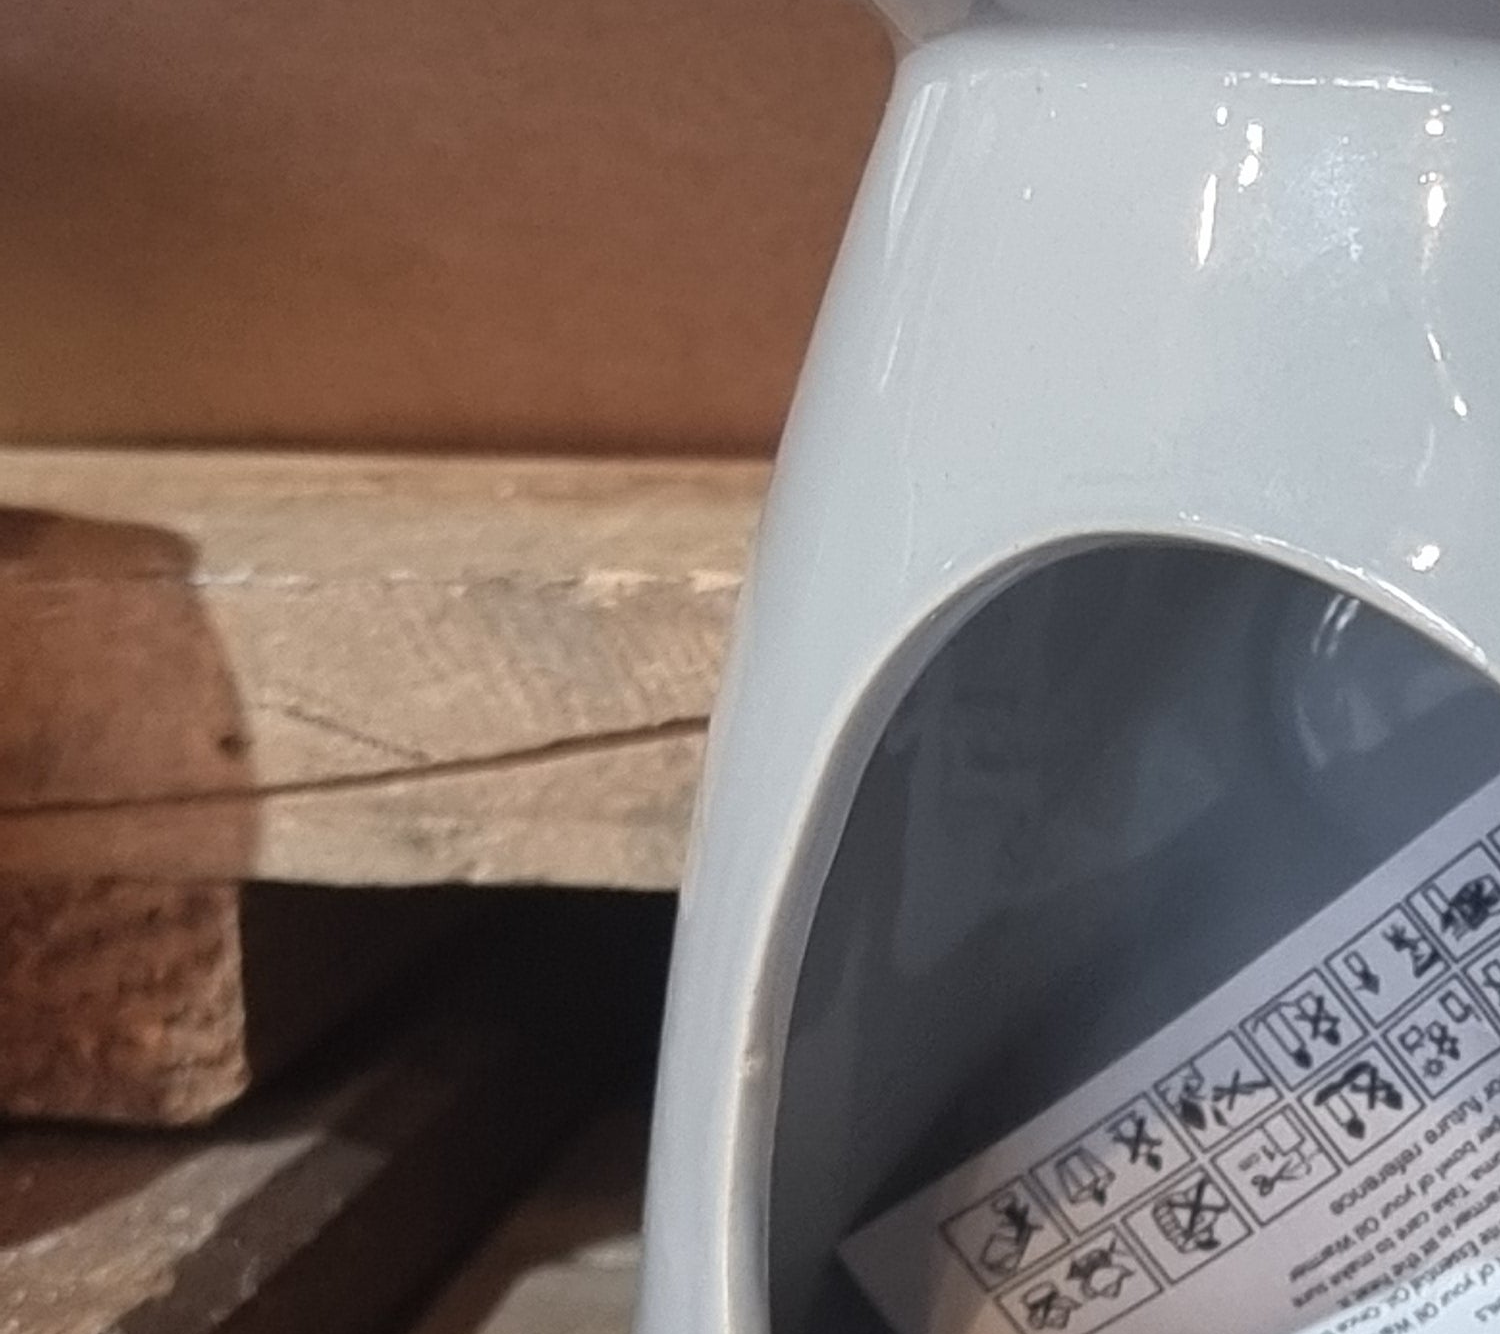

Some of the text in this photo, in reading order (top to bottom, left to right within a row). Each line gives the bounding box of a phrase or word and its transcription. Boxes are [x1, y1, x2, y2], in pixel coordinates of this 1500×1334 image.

[1423, 1095, 1484, 1146] future
[1434, 1139, 1479, 1180] bowl
[1329, 1141, 1424, 1216] reference
[1417, 1173, 1436, 1196] of
[1379, 1182, 1417, 1221] your
[1430, 1183, 1471, 1214] Take
[1352, 1215, 1381, 1242] Oil
[1394, 1210, 1430, 1242] care
[1436, 1223, 1455, 1241] is
[1289, 1234, 1357, 1283] Warmer
[1374, 1236, 1397, 1256] to
[1329, 1249, 1376, 1287] make
[1391, 1251, 1423, 1282] the
[1408, 1239, 1481, 1295] Essential
[1477, 1262, 1496, 1287] of
[1291, 1281, 1329, 1310] sure
[1439, 1272, 1476, 1308] your
[1336, 1306, 1381, 1334] Once
[1412, 1301, 1440, 1325] Oil
